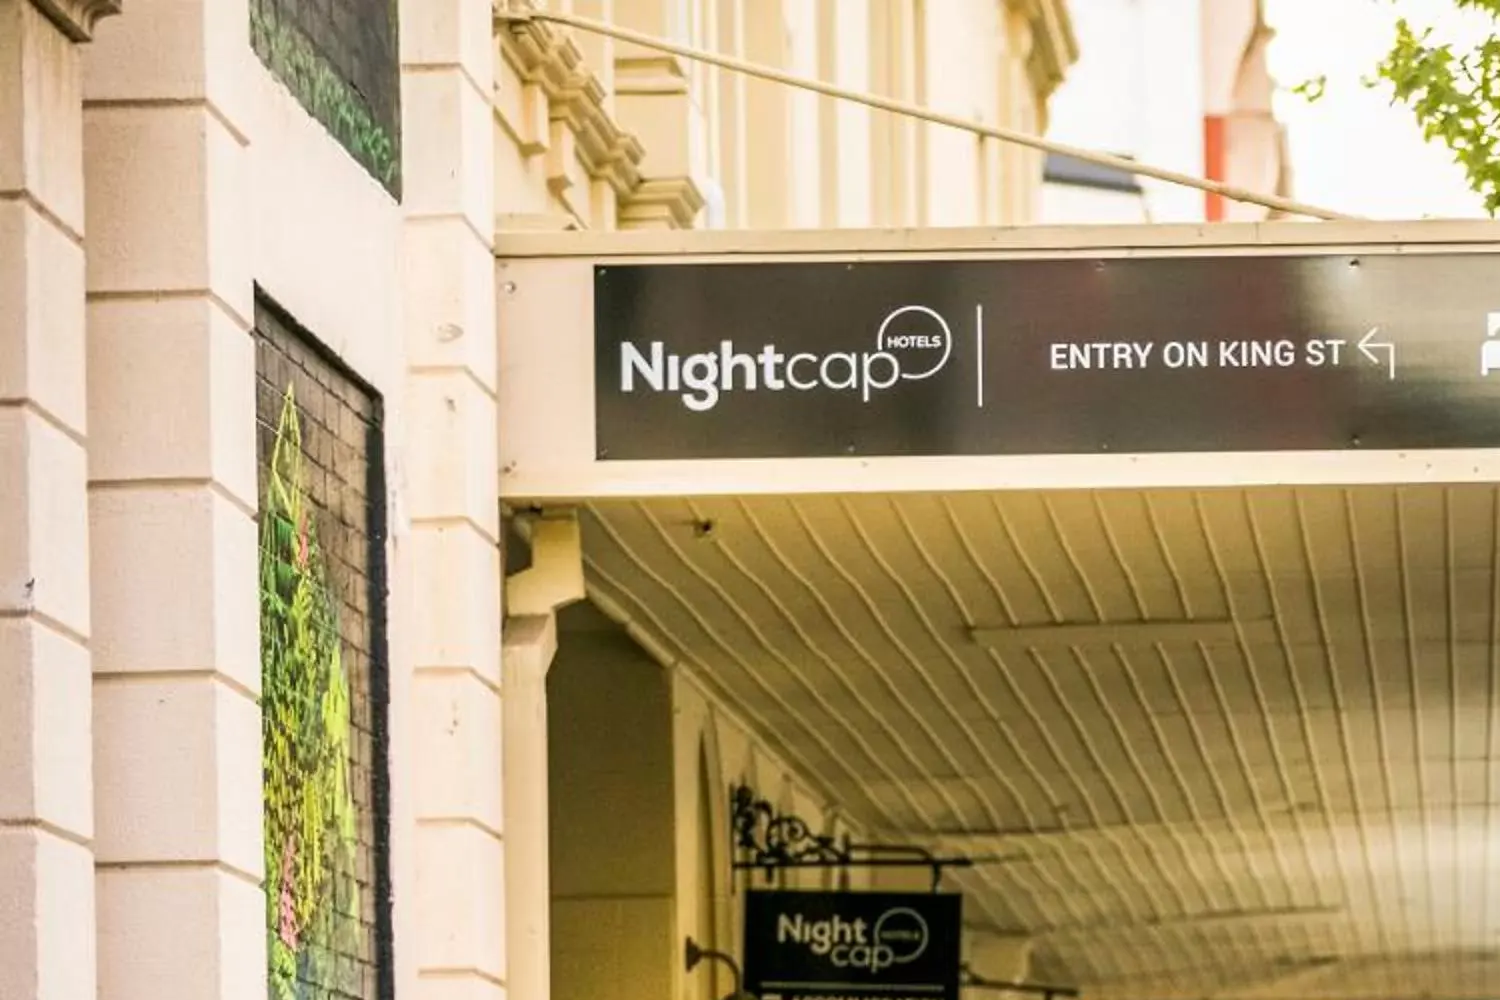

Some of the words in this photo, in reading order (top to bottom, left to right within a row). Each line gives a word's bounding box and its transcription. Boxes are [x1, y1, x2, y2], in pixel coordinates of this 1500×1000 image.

[887, 335, 942, 348] HOTELS
[1050, 342, 1153, 370] ENTRY
[1162, 341, 1209, 369] ON
[1219, 340, 1296, 367] KING
[1305, 339, 1345, 366] ST
[620, 340, 899, 411] Nightcap
[777, 912, 868, 955] Night
[831, 945, 895, 974] cap
